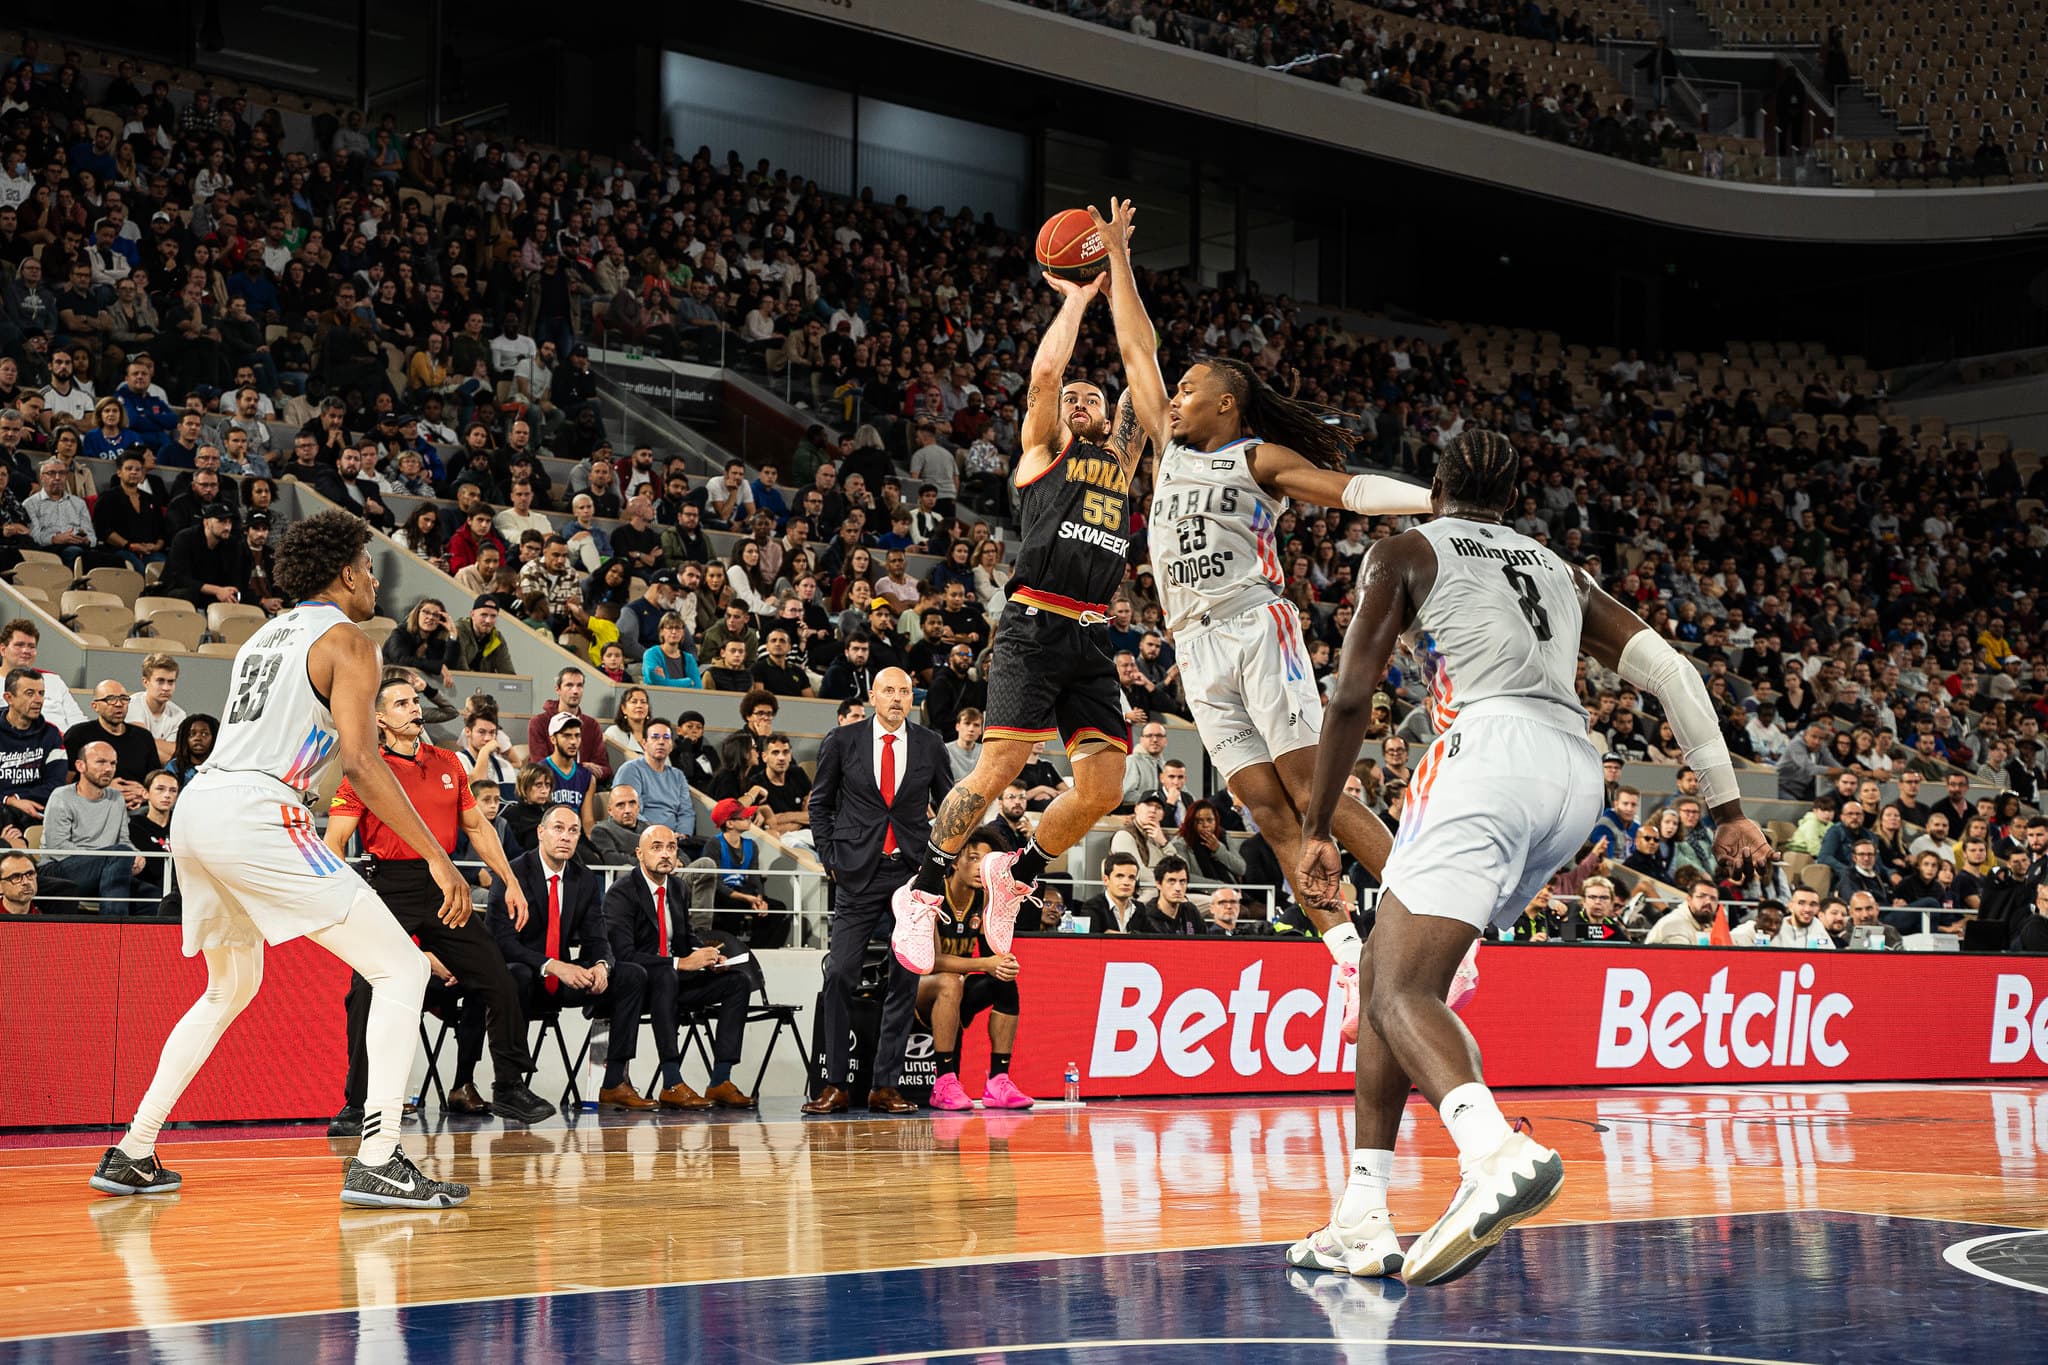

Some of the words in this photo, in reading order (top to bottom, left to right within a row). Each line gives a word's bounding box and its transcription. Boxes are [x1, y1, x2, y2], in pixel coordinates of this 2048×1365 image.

[1082, 489, 1124, 532] 55
[1153, 487, 1239, 528] PARIS
[1176, 514, 1208, 556] 23
[1501, 563, 1553, 642] 8
[228, 653, 283, 724] 33
[1448, 731, 1461, 758] 8
[1088, 959, 1356, 1078] Betcl
[1595, 963, 1854, 1070] Betclic
